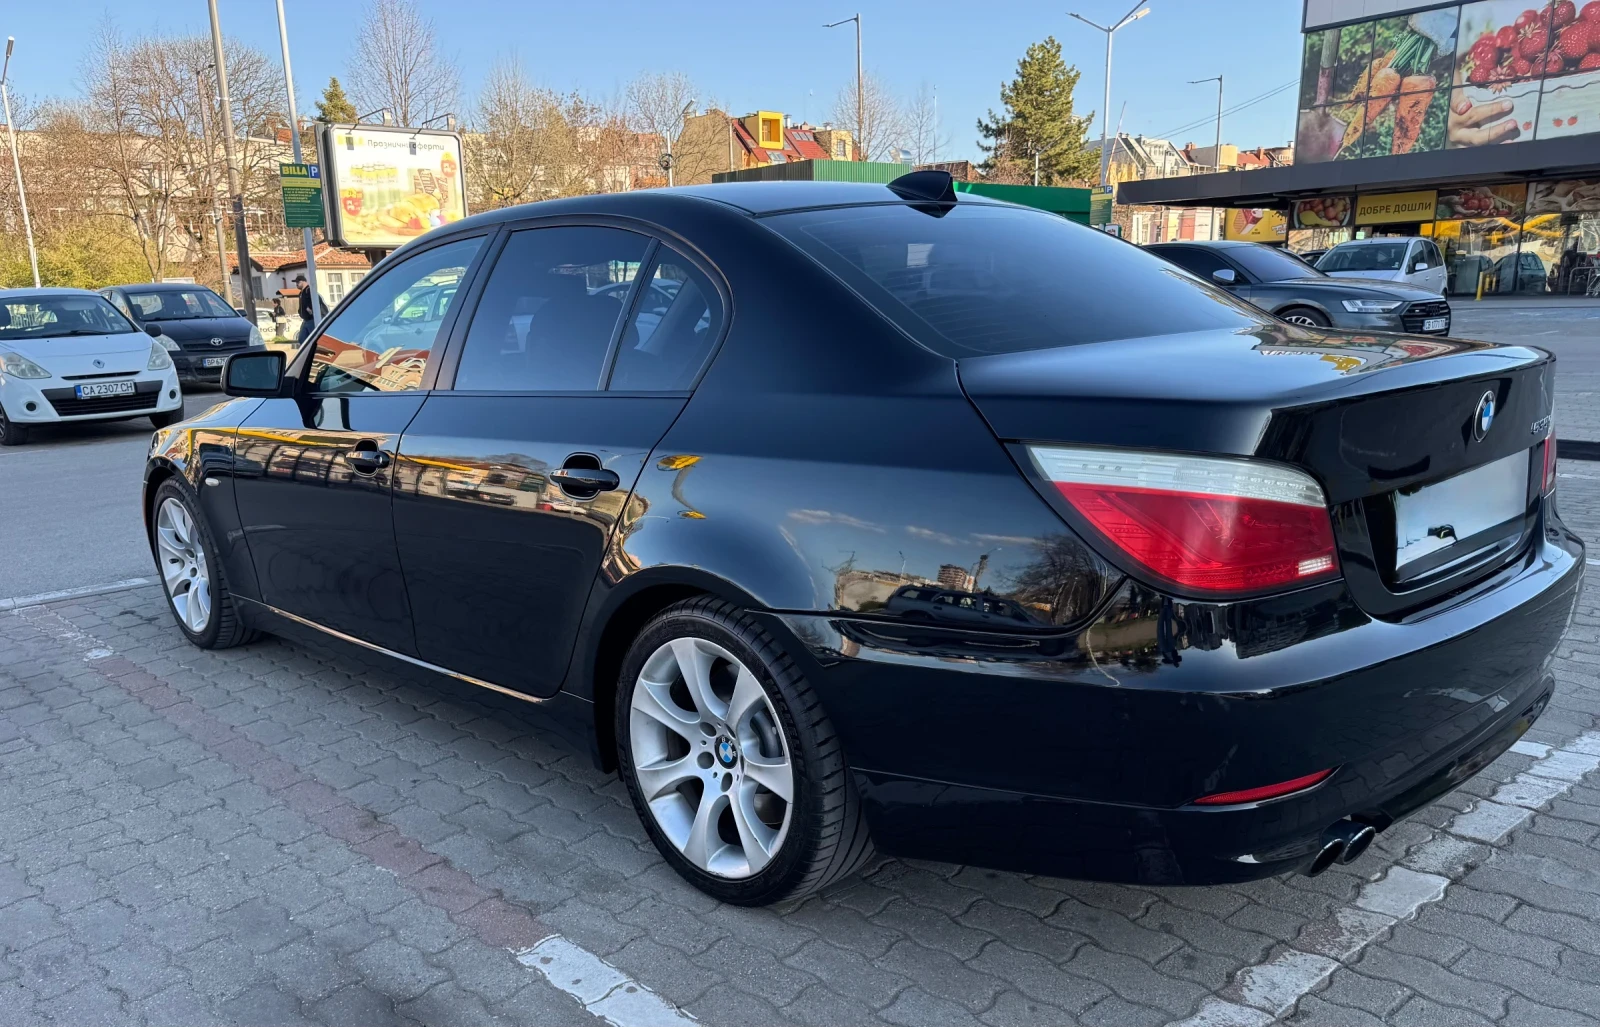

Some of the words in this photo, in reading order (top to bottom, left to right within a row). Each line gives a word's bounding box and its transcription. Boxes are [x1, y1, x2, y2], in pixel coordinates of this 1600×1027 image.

[282, 166, 308, 176] BILLA
[310, 166, 318, 177] P
[1359, 205, 1391, 217] ДОБРЕ
[1393, 202, 1432, 214] ДОШЛИ
[82, 385, 96, 396] CA
[96, 384, 119, 395] 2307
[120, 382, 134, 392] CH
